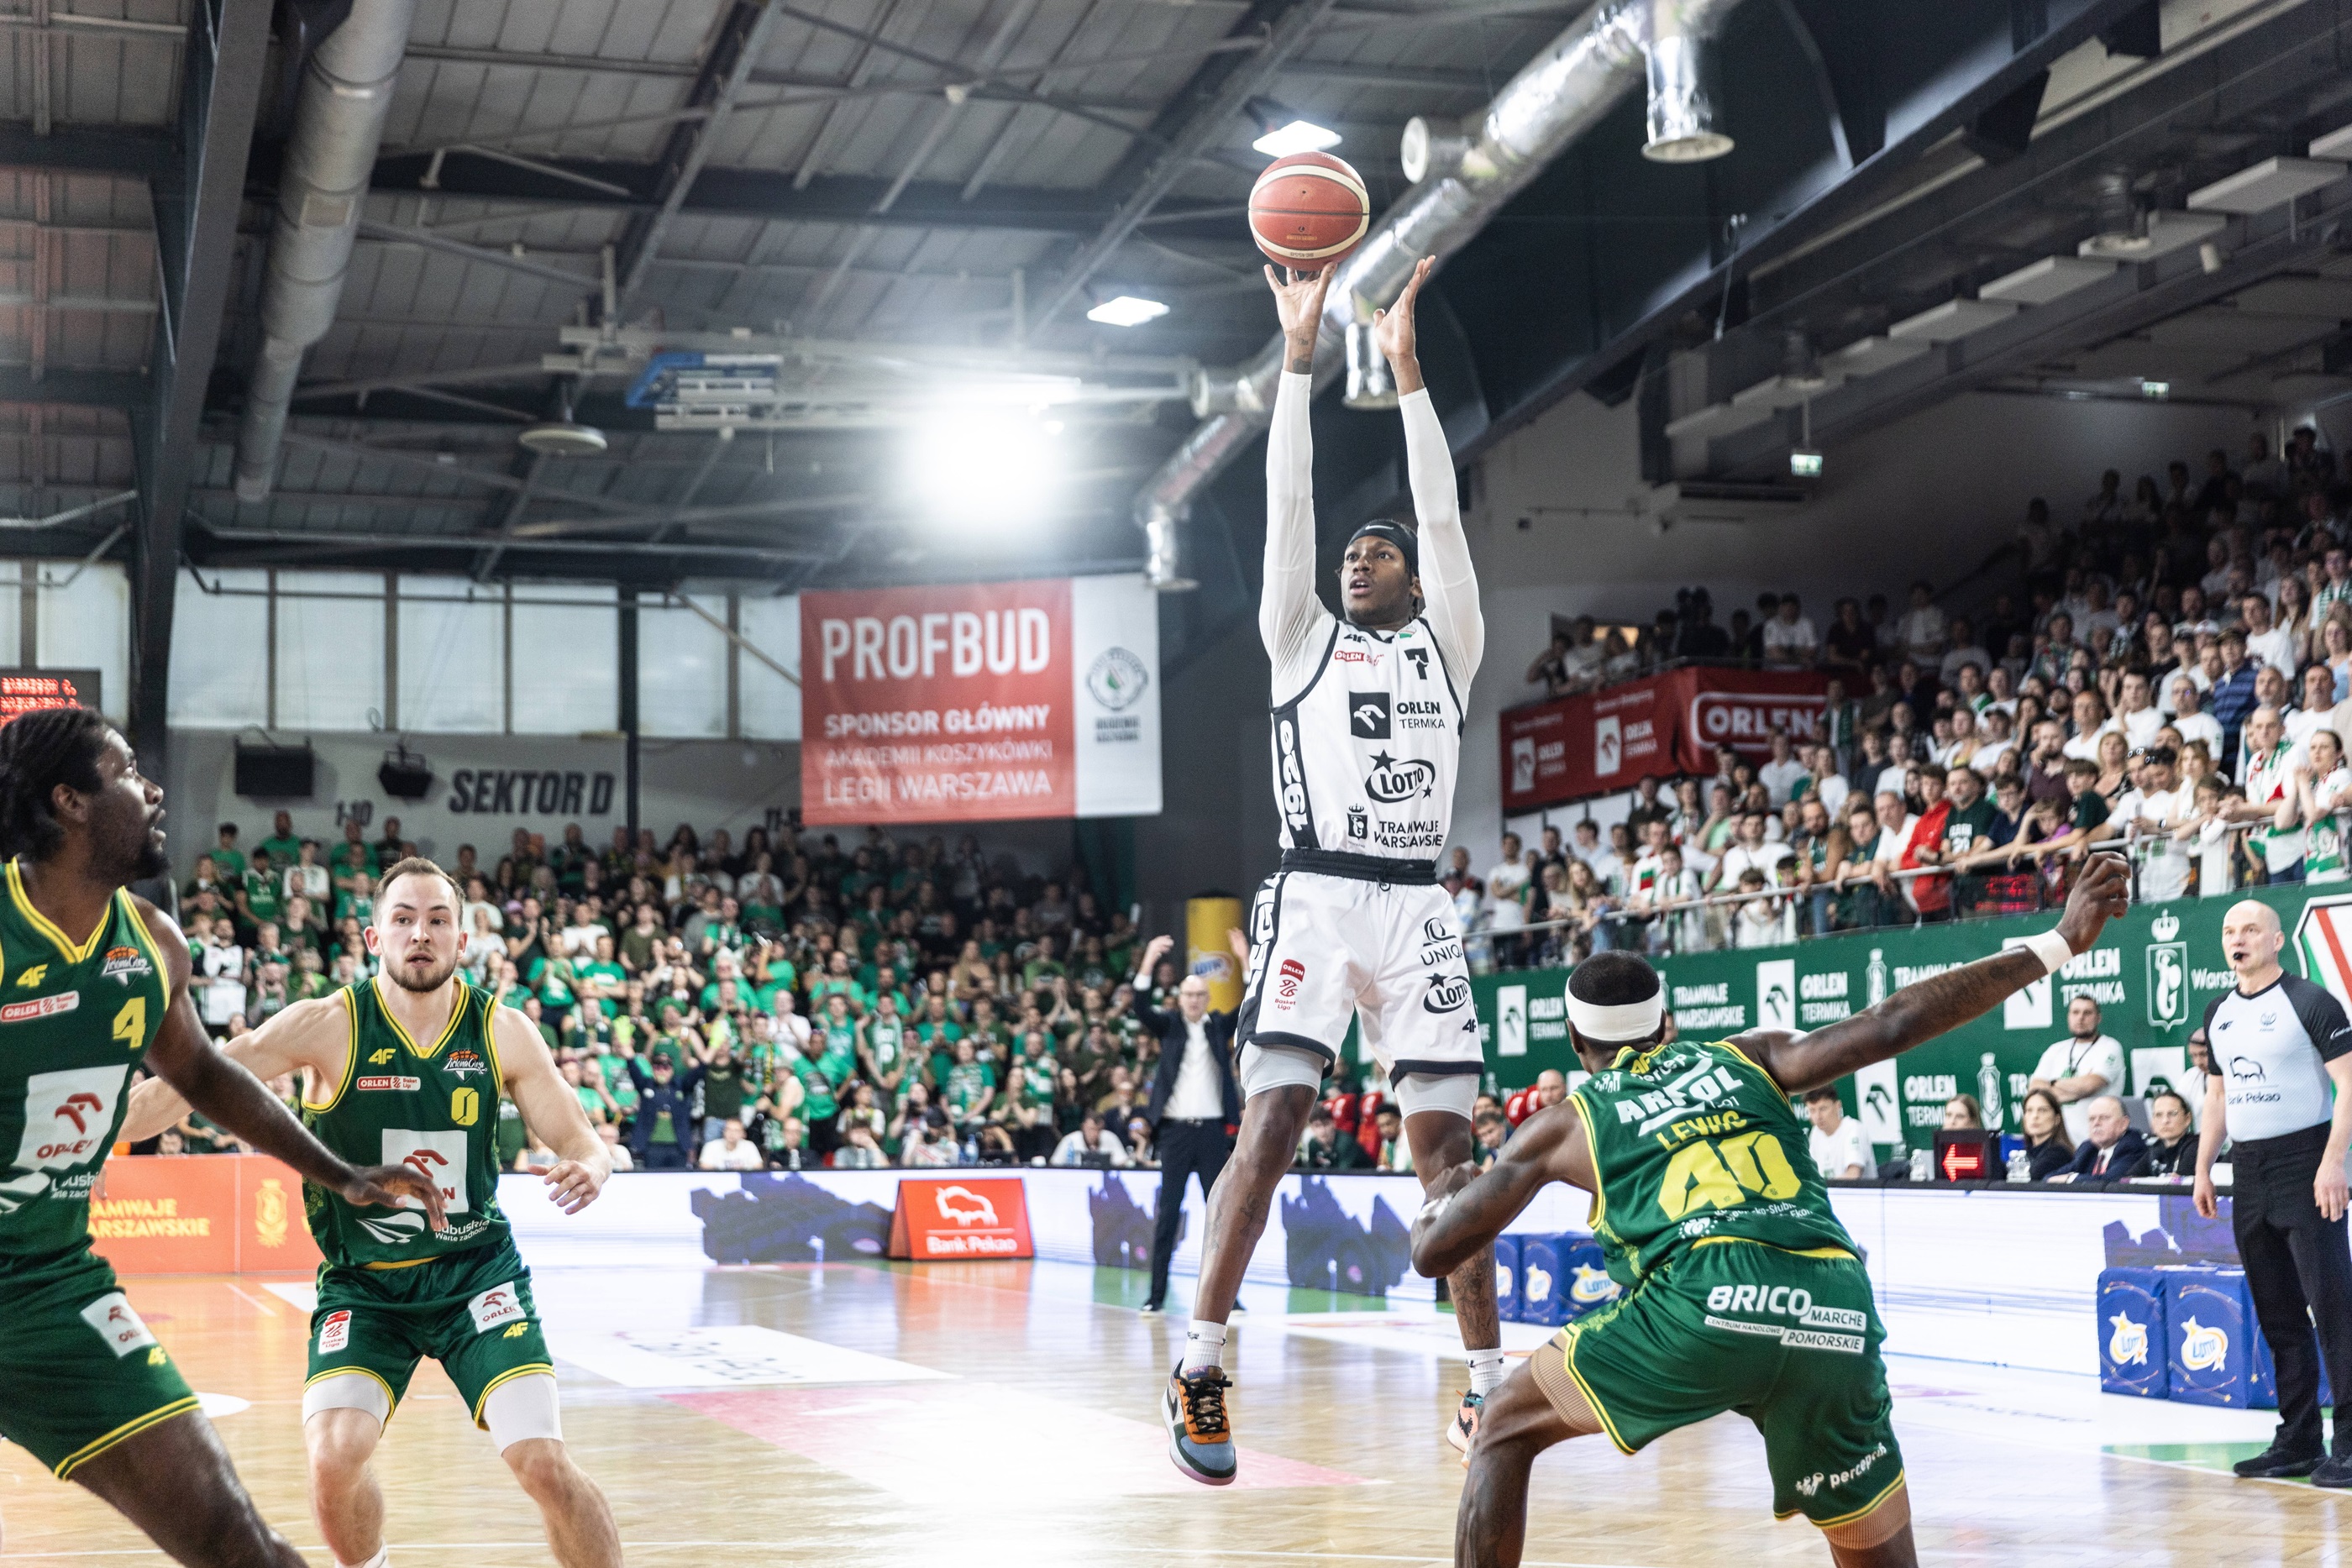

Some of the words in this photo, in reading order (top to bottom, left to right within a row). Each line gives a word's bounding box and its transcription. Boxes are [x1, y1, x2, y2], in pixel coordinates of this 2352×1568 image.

[821, 608, 1050, 682] PROFBUD
[1397, 701, 1441, 715] ORLEN
[824, 711, 939, 738] SPONSOR
[943, 703, 1050, 734] GŁÓWNY
[1399, 718, 1446, 729] TERMIKA
[1705, 705, 1814, 737] ORLEN
[824, 746, 922, 770] AKADEMII
[926, 737, 1053, 765] KOSZYKÓWKI
[824, 778, 890, 807] LEGII
[897, 770, 1053, 800] WARSZAWA
[1379, 768, 1424, 794] LOTTO
[449, 770, 587, 815] SEKTOR
[590, 772, 616, 815] D
[1283, 964, 1304, 976] ORLEN
[2061, 948, 2121, 980] ORLEN
[16, 964, 48, 988] 4F
[1799, 973, 1848, 999] ORLEN
[1436, 983, 1468, 1006] LOTTO
[5, 1004, 38, 1018] ORLEN
[1802, 1001, 1851, 1023] TERMIKA
[113, 997, 145, 1048] 4
[369, 1049, 396, 1065] 4F
[360, 1079, 389, 1088] ORLEN
[1904, 1075, 1957, 1102] ORLEN
[451, 1087, 479, 1125] 0
[1614, 1065, 1744, 1125] ARFOL
[1907, 1105, 1946, 1127] TERMI
[1658, 1131, 1802, 1222] 40
[89, 1198, 177, 1218] AMWAJE
[88, 1218, 212, 1238] ARSZAWSKIE
[433, 1219, 490, 1235] ubuskie
[435, 1231, 458, 1242] Warte
[459, 1225, 488, 1241] zachodu
[926, 1236, 968, 1254] Bank
[1707, 1284, 1811, 1316] BRICO
[483, 1306, 517, 1322] ORLEN
[503, 1321, 528, 1338] 4F
[1708, 1318, 1740, 1329] CENTRUM
[1741, 1324, 1782, 1335] HANDLOWE
[1788, 1331, 1861, 1350] POMORSKIE
